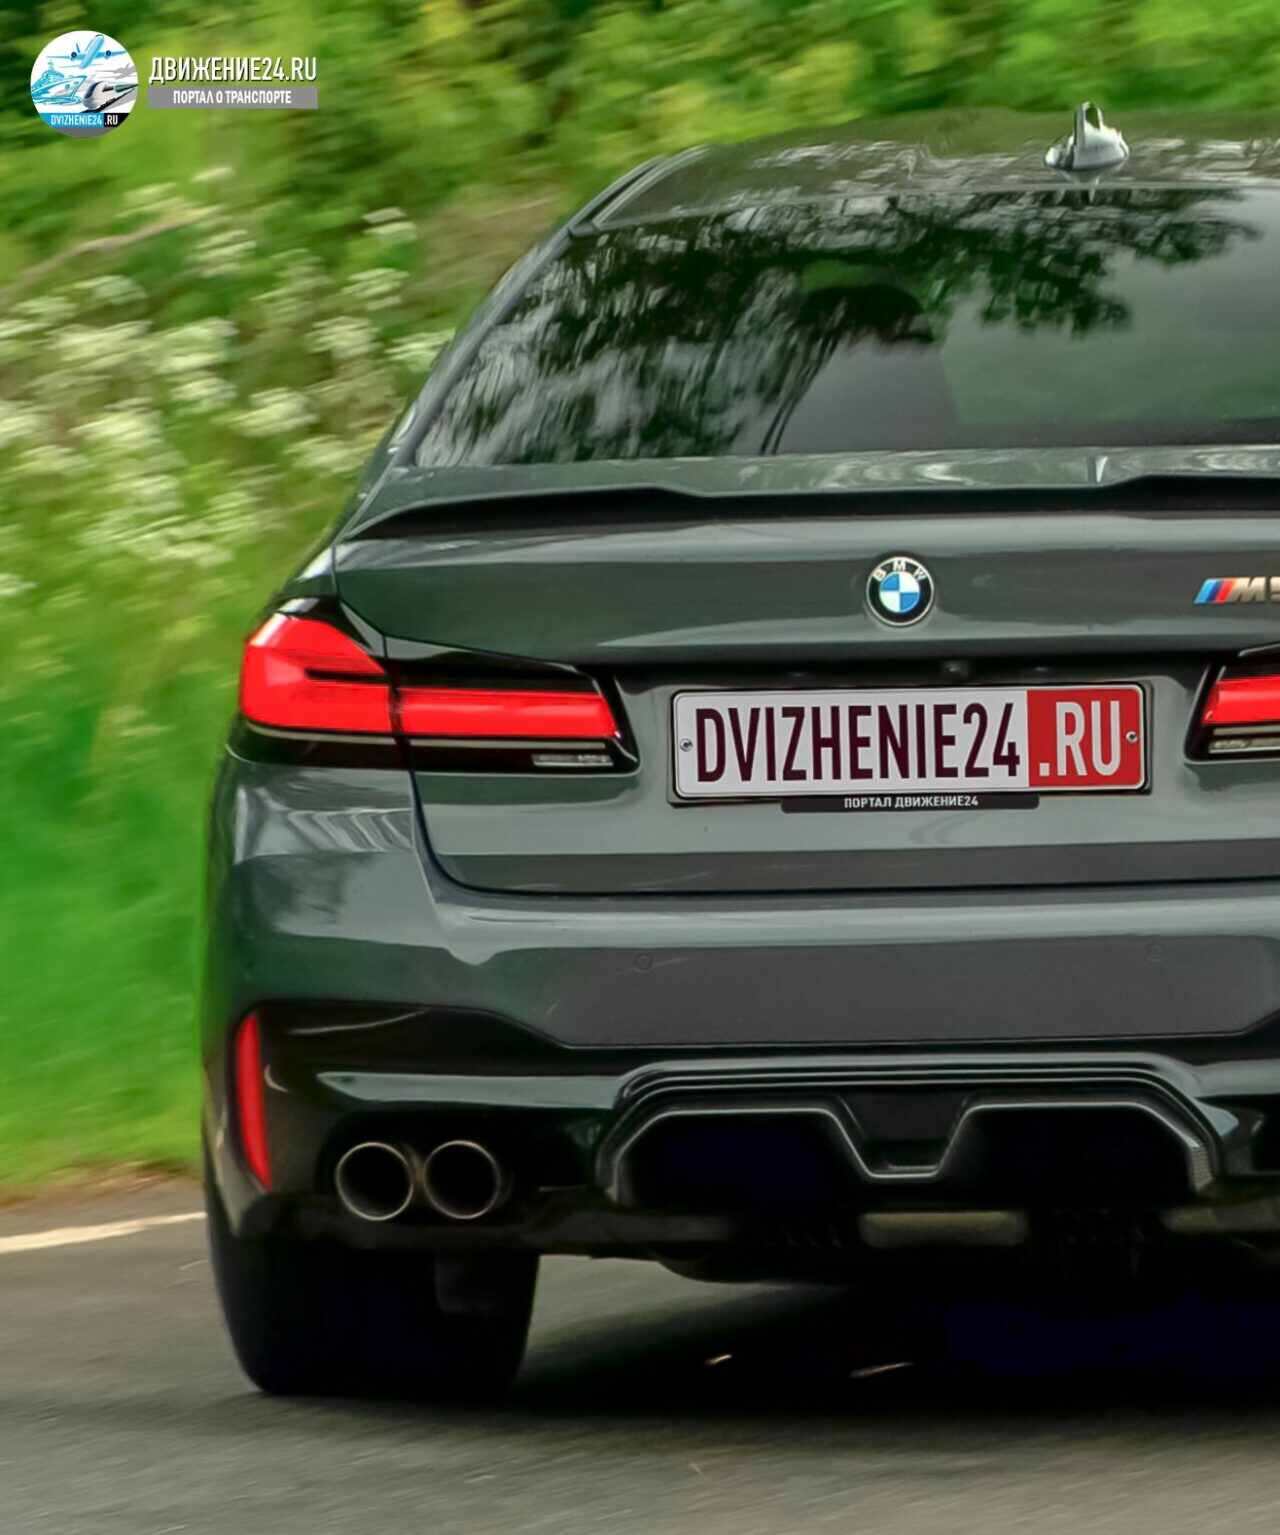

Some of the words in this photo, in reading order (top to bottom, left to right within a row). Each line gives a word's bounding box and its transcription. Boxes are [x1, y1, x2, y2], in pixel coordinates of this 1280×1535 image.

[872, 560, 929, 582] BMW
[844, 797, 891, 809] ПОРТАЛ
[894, 795, 979, 808] ДВИЖЕНИЕ24
